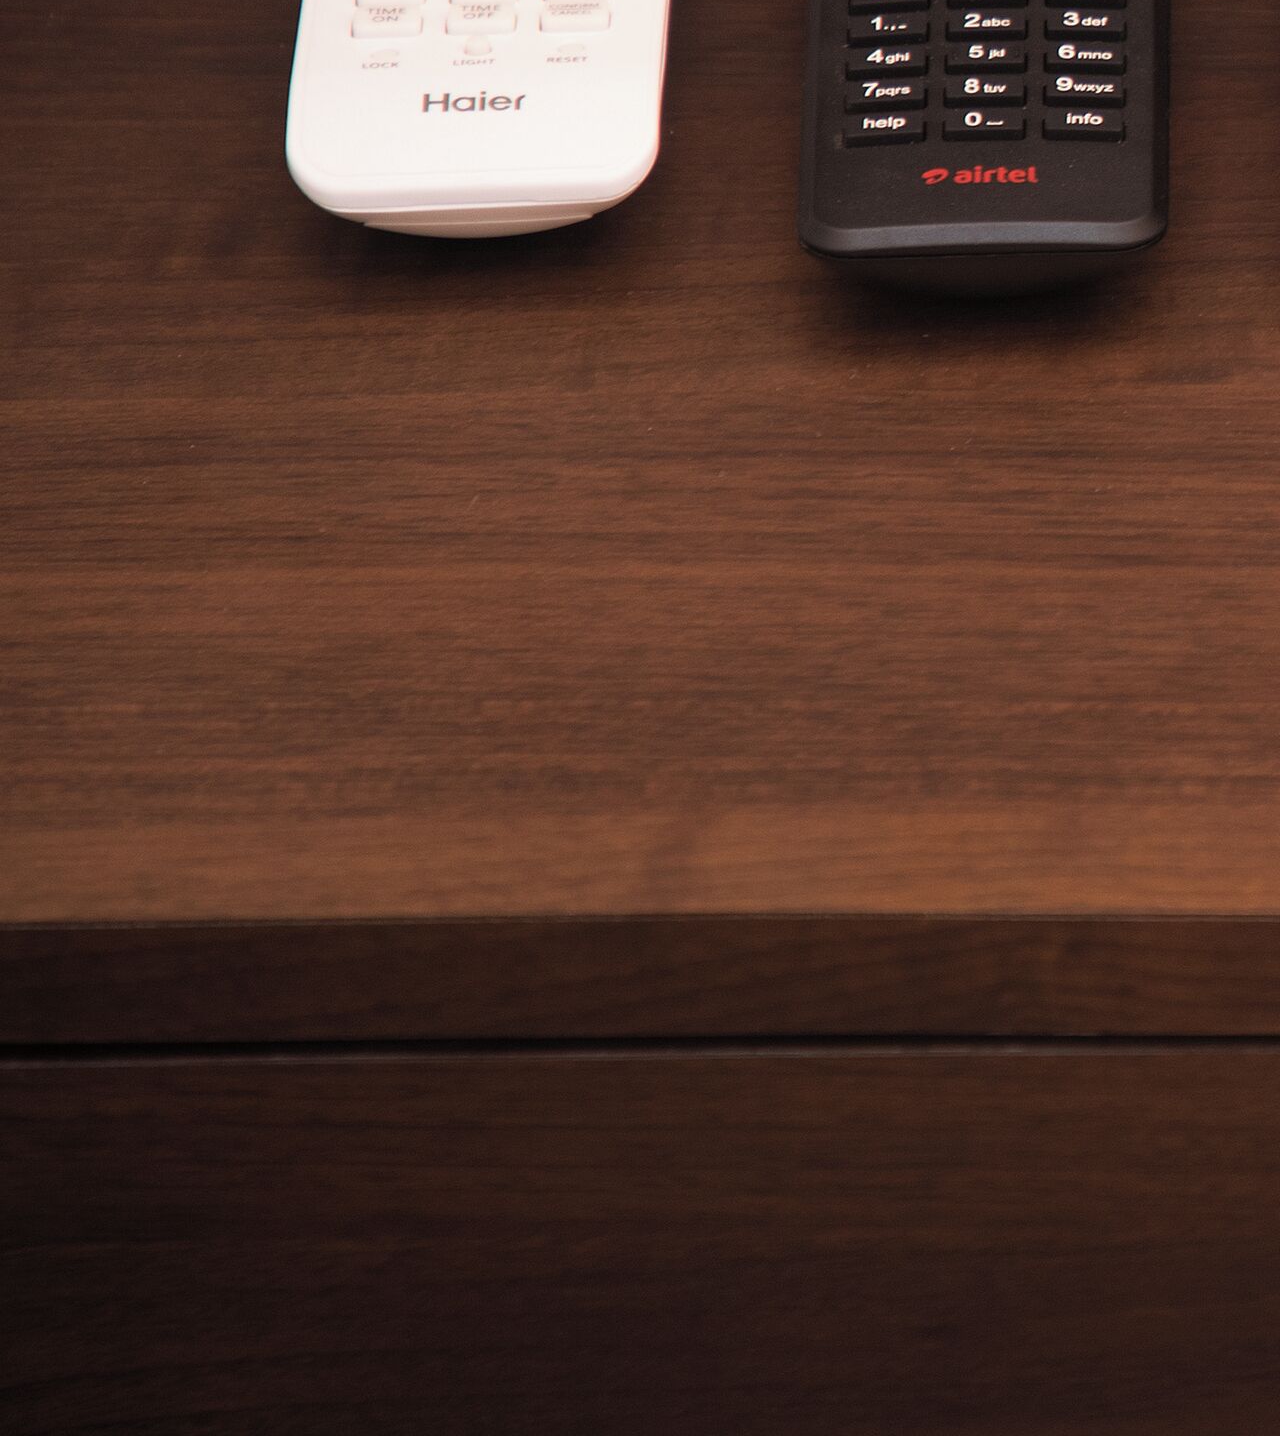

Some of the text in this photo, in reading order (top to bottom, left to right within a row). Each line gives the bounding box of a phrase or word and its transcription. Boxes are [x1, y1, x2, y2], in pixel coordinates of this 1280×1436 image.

[372, 15, 400, 23] ON
[462, 12, 496, 20] OFF
[452, 58, 497, 66] LIGHT
[546, 56, 589, 64] RESET
[362, 62, 400, 70] LOCK
[422, 91, 526, 113] Haier
[1065, 112, 1103, 126] info
[862, 116, 907, 131] help
[953, 165, 1039, 184] airtel
